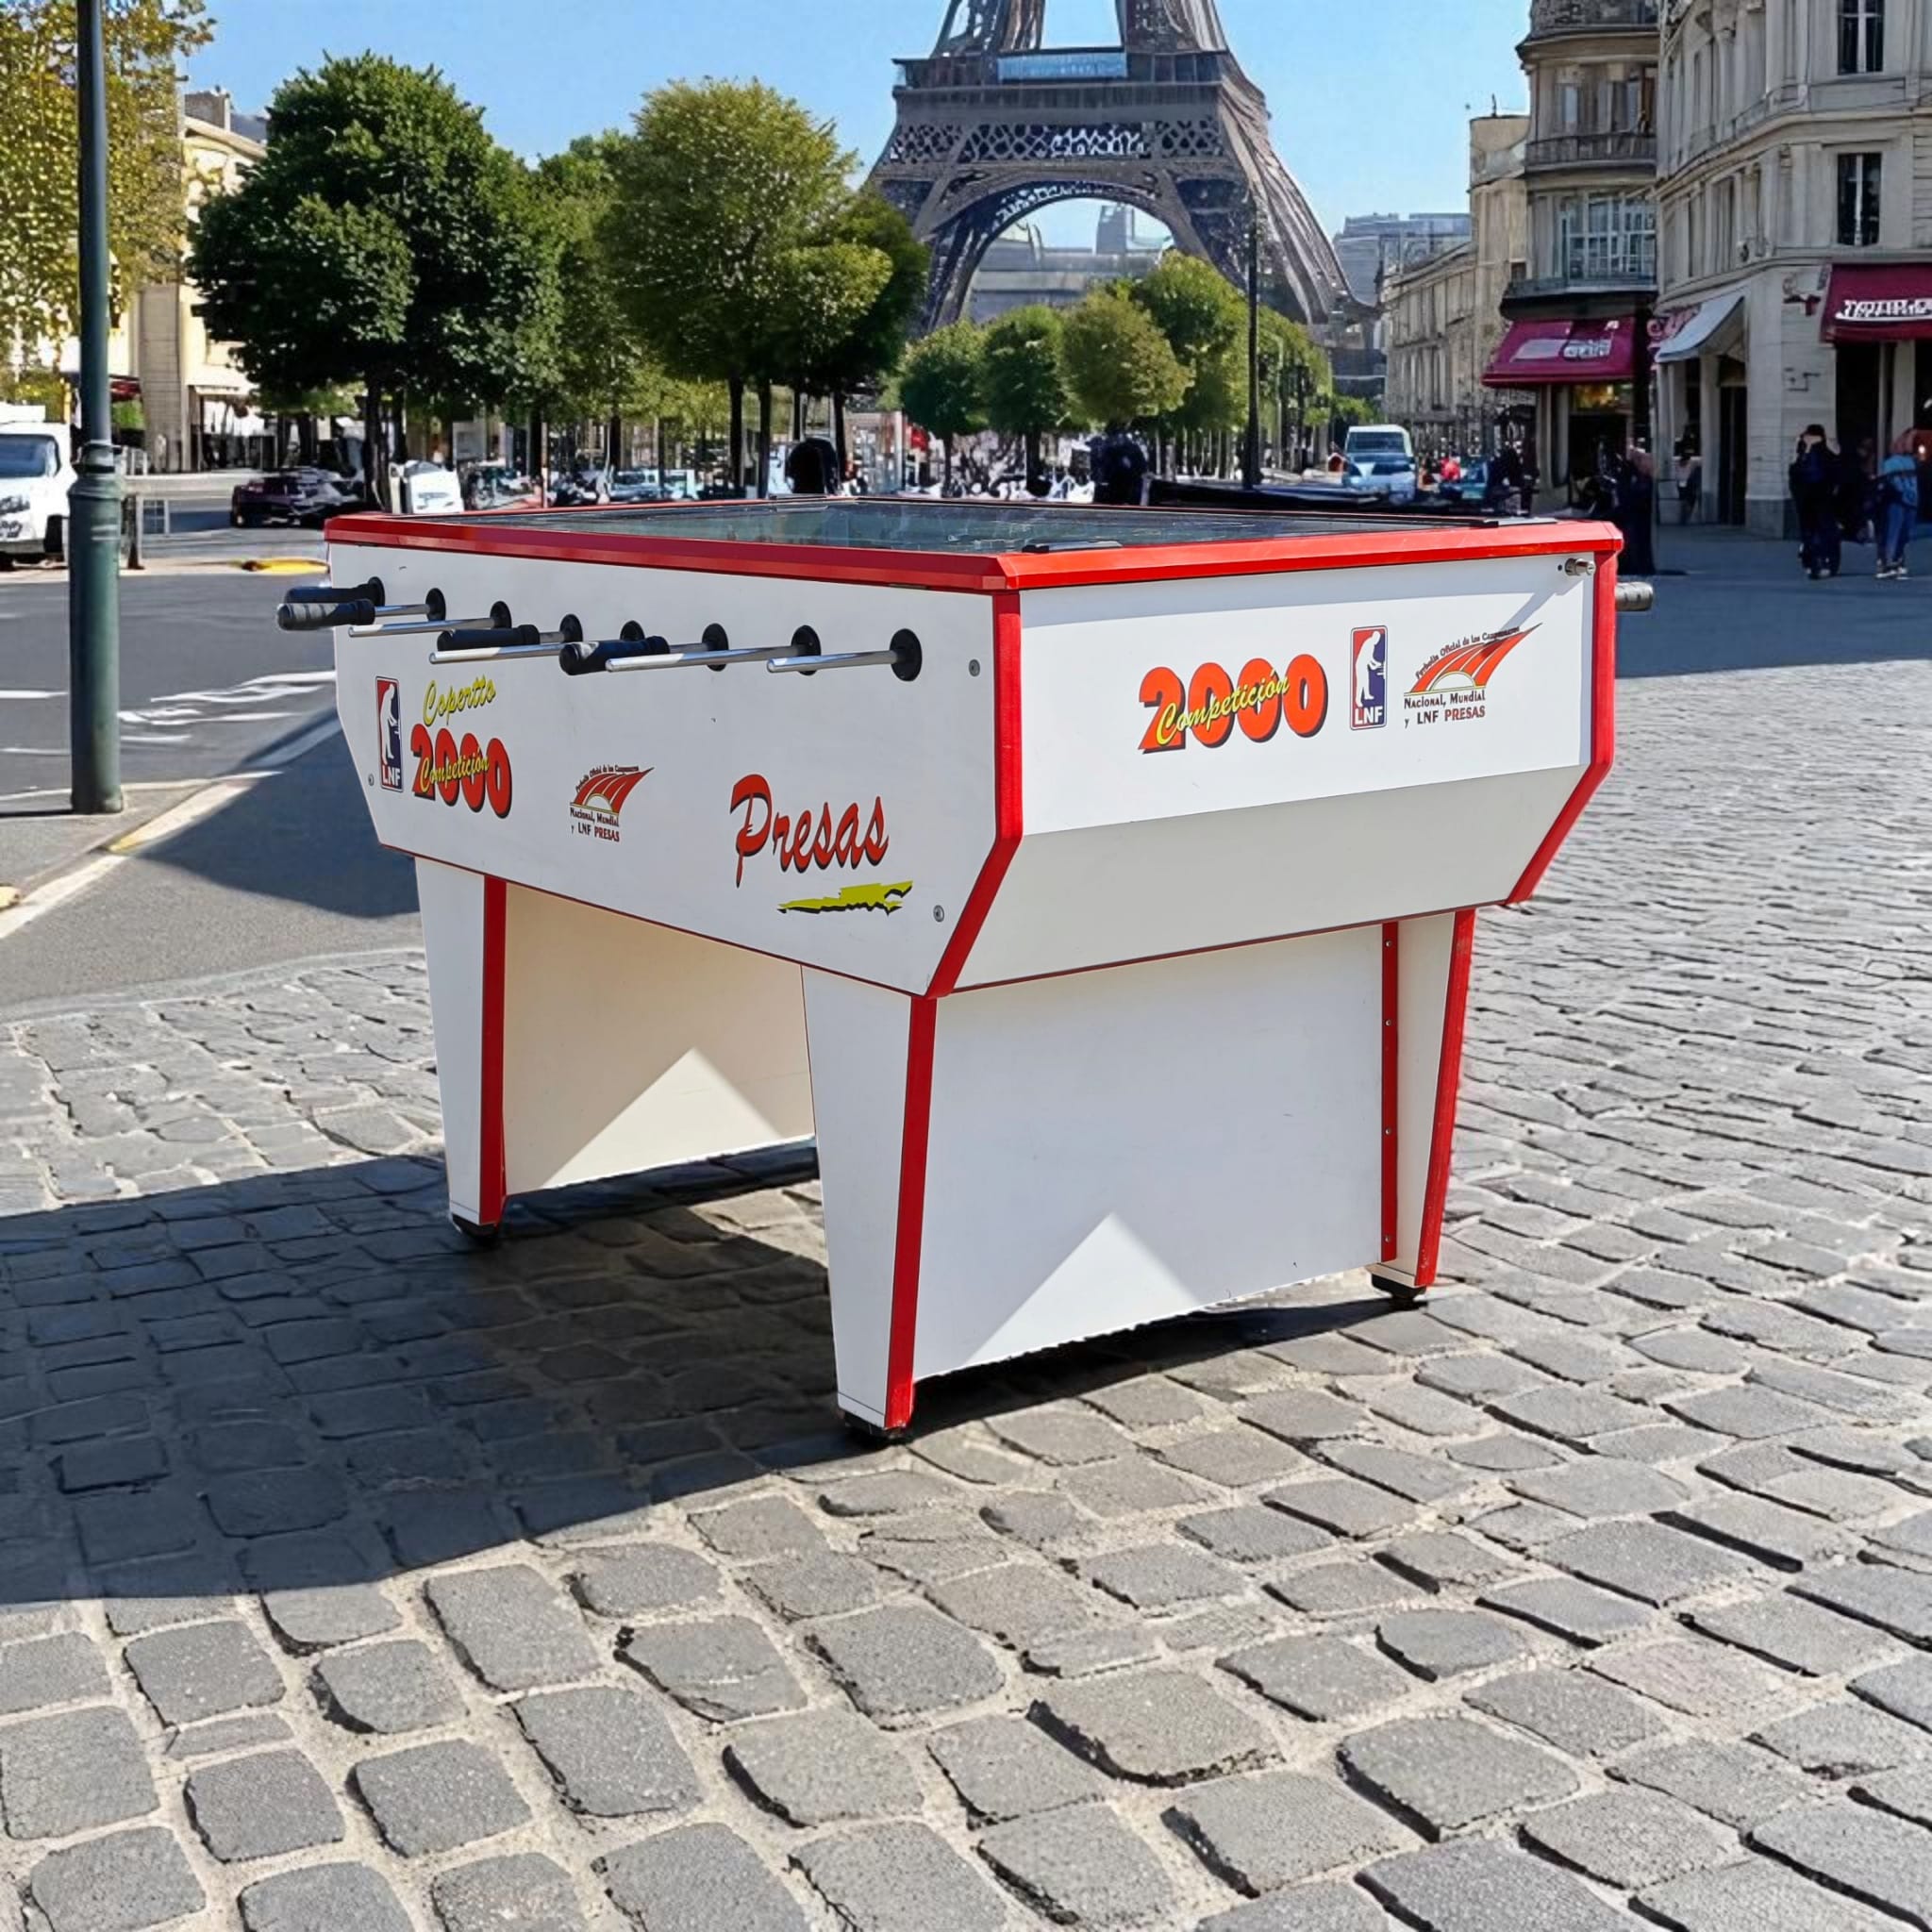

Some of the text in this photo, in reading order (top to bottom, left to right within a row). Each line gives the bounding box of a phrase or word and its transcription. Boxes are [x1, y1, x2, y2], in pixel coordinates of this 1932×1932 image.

[1138, 653, 1328, 754] 2000
[1156, 667, 1291, 745] Competición
[1450, 690, 1486, 705] Mundial
[1355, 706, 1383, 725] LNF
[1417, 710, 1440, 725] LNF
[1444, 705, 1486, 723] PRESAS
[382, 764, 401, 787] LNF
[409, 723, 513, 820] 2000
[420, 747, 490, 793] Competición
[578, 822, 591, 836] LNF
[594, 825, 621, 842] PRESAS
[730, 774, 890, 889] Presas
